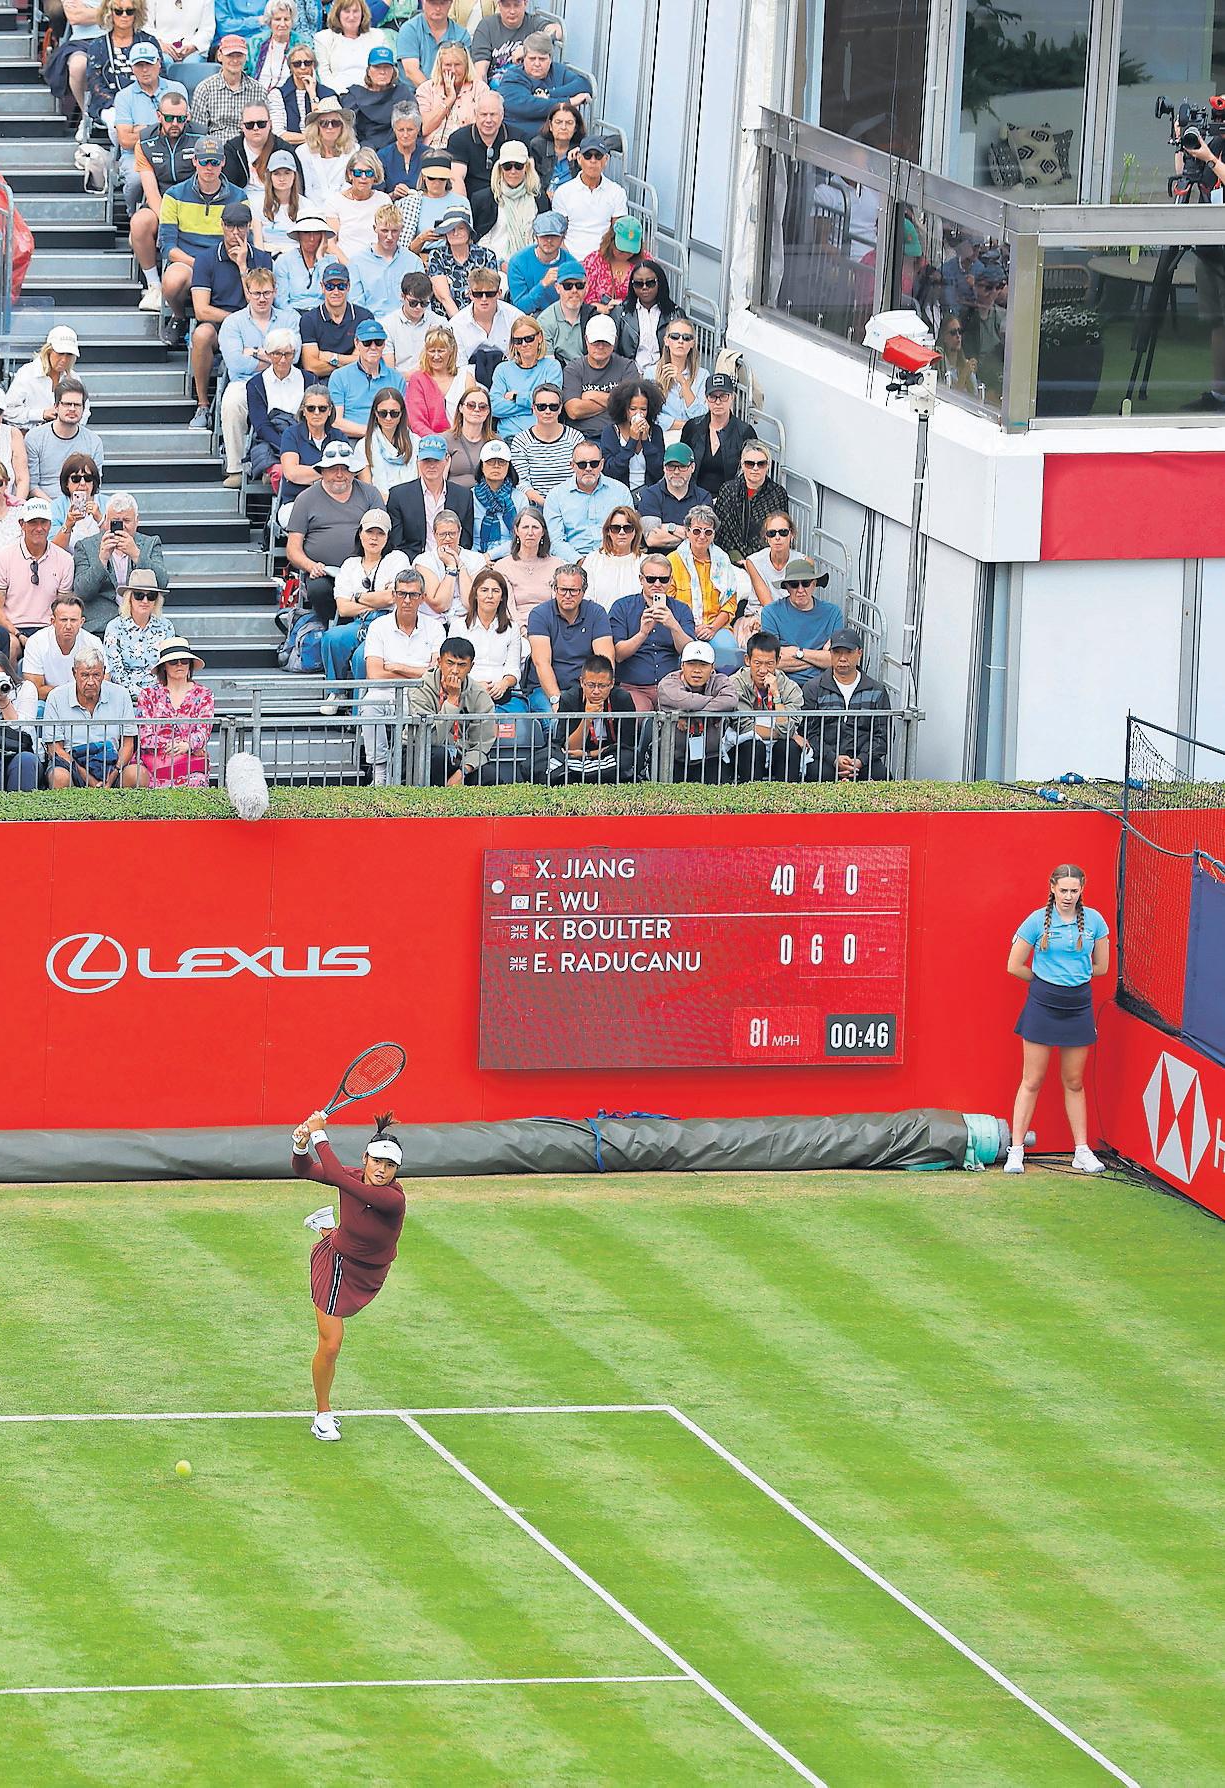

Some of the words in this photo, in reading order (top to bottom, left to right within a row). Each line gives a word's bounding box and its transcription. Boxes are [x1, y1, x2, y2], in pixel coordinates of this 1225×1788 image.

[535, 859, 556, 879] X.
[561, 858, 635, 879] JIANG
[770, 864, 795, 896] 40
[812, 864, 825, 895] 4
[845, 864, 859, 896] 0
[535, 891, 553, 912] F.
[559, 891, 599, 912] WU
[534, 920, 556, 940] K.
[562, 918, 672, 940] BOULTER
[137, 945, 372, 979] LEXUS
[533, 952, 553, 973] E.
[560, 951, 701, 973] RADUCANU
[780, 934, 793, 966] 0
[810, 933, 823, 965] 6
[843, 933, 856, 965] 0
[749, 1017, 769, 1048] 81
[771, 1034, 800, 1047] MPH
[830, 1022, 889, 1049] 00:46
